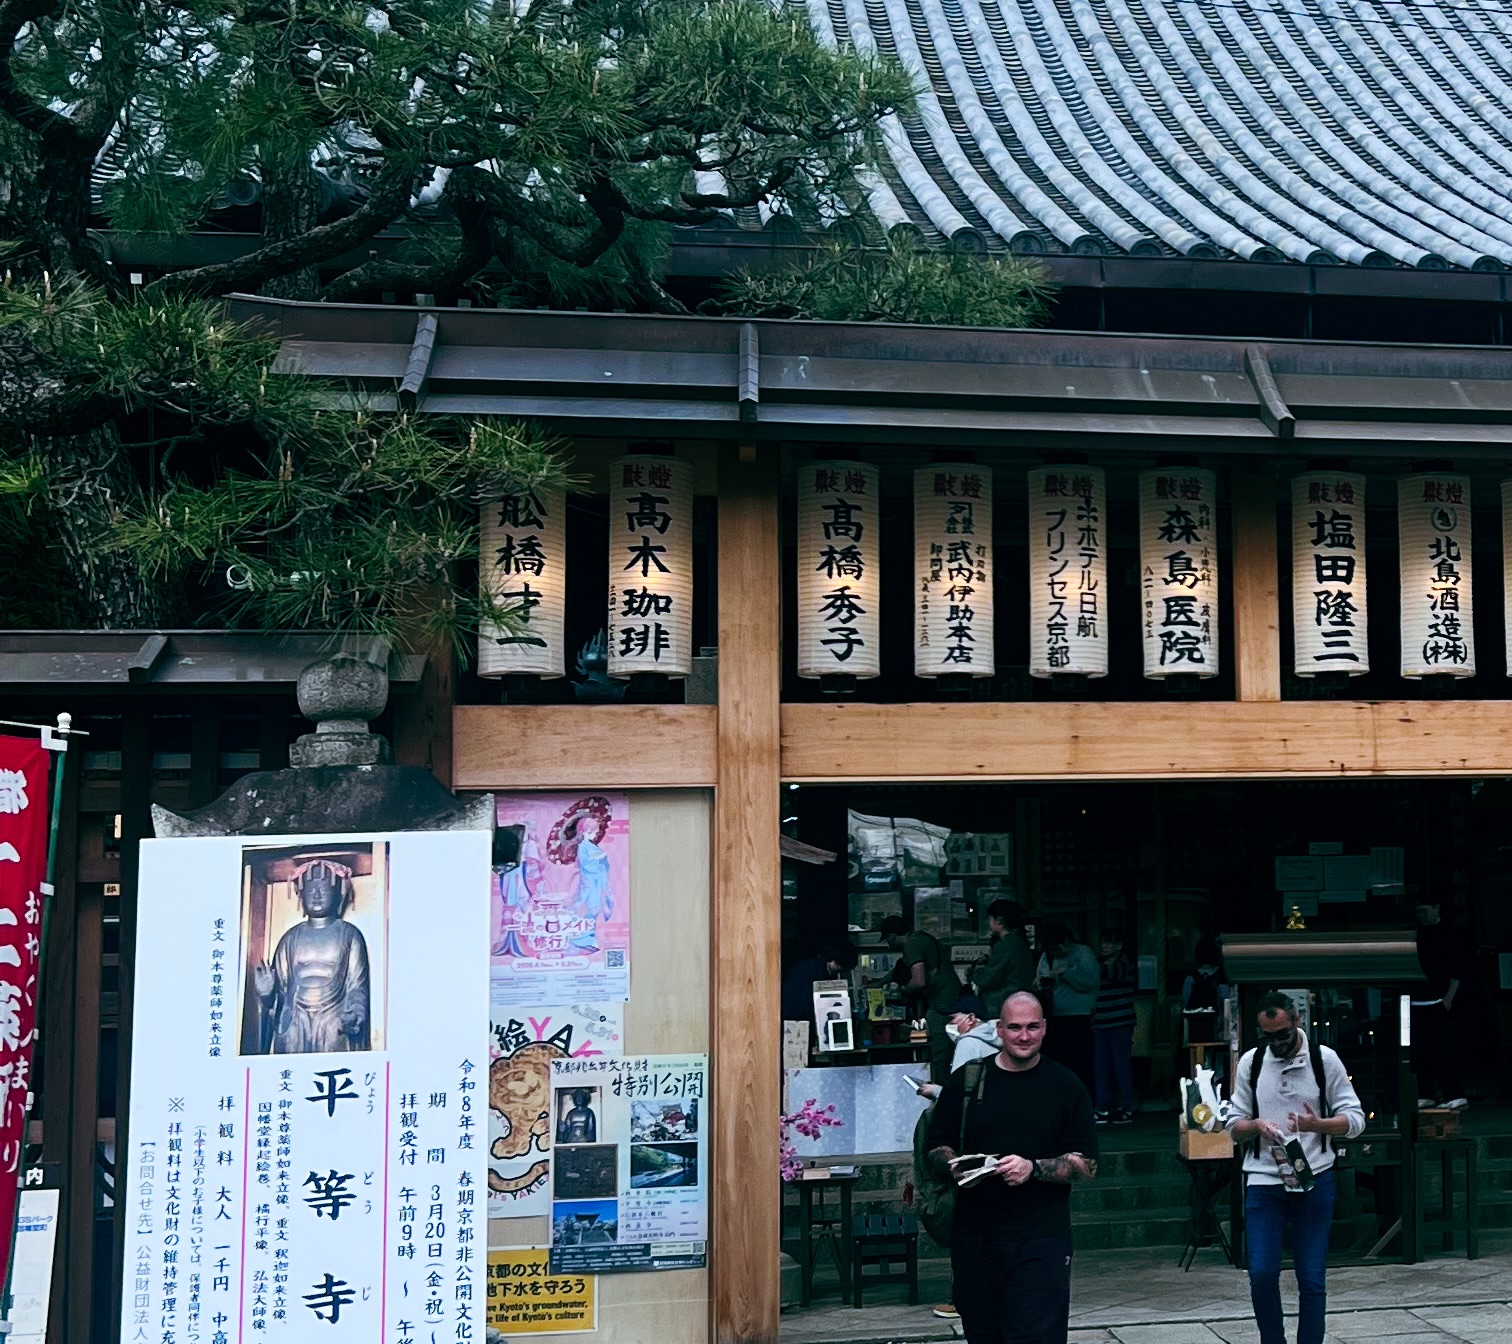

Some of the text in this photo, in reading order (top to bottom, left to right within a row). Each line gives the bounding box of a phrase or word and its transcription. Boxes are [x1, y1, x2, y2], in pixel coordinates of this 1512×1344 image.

[941, 540, 976, 664] 武内伊助本店
[1046, 509, 1070, 667] プリンセス京都
[1077, 525, 1099, 638] ホテル日航
[1157, 504, 1205, 666] 森島医院
[1309, 509, 1359, 663] 塩田隆三
[209, 918, 226, 1057] 重文 御本尊薬師如来立像
[280, 1069, 292, 1092] 重文
[457, 1059, 476, 1149] 令和8年度
[612, 1071, 703, 1098] 特別公開
[217, 1094, 235, 1166] 拝観料
[399, 1093, 418, 1165] 拝観受付
[215, 1186, 233, 1220] 大人
[398, 1187, 417, 1259] 午前9時
[213, 1245, 231, 1292] 一千円
[499, 1302, 529, 1313] Kyoto's
